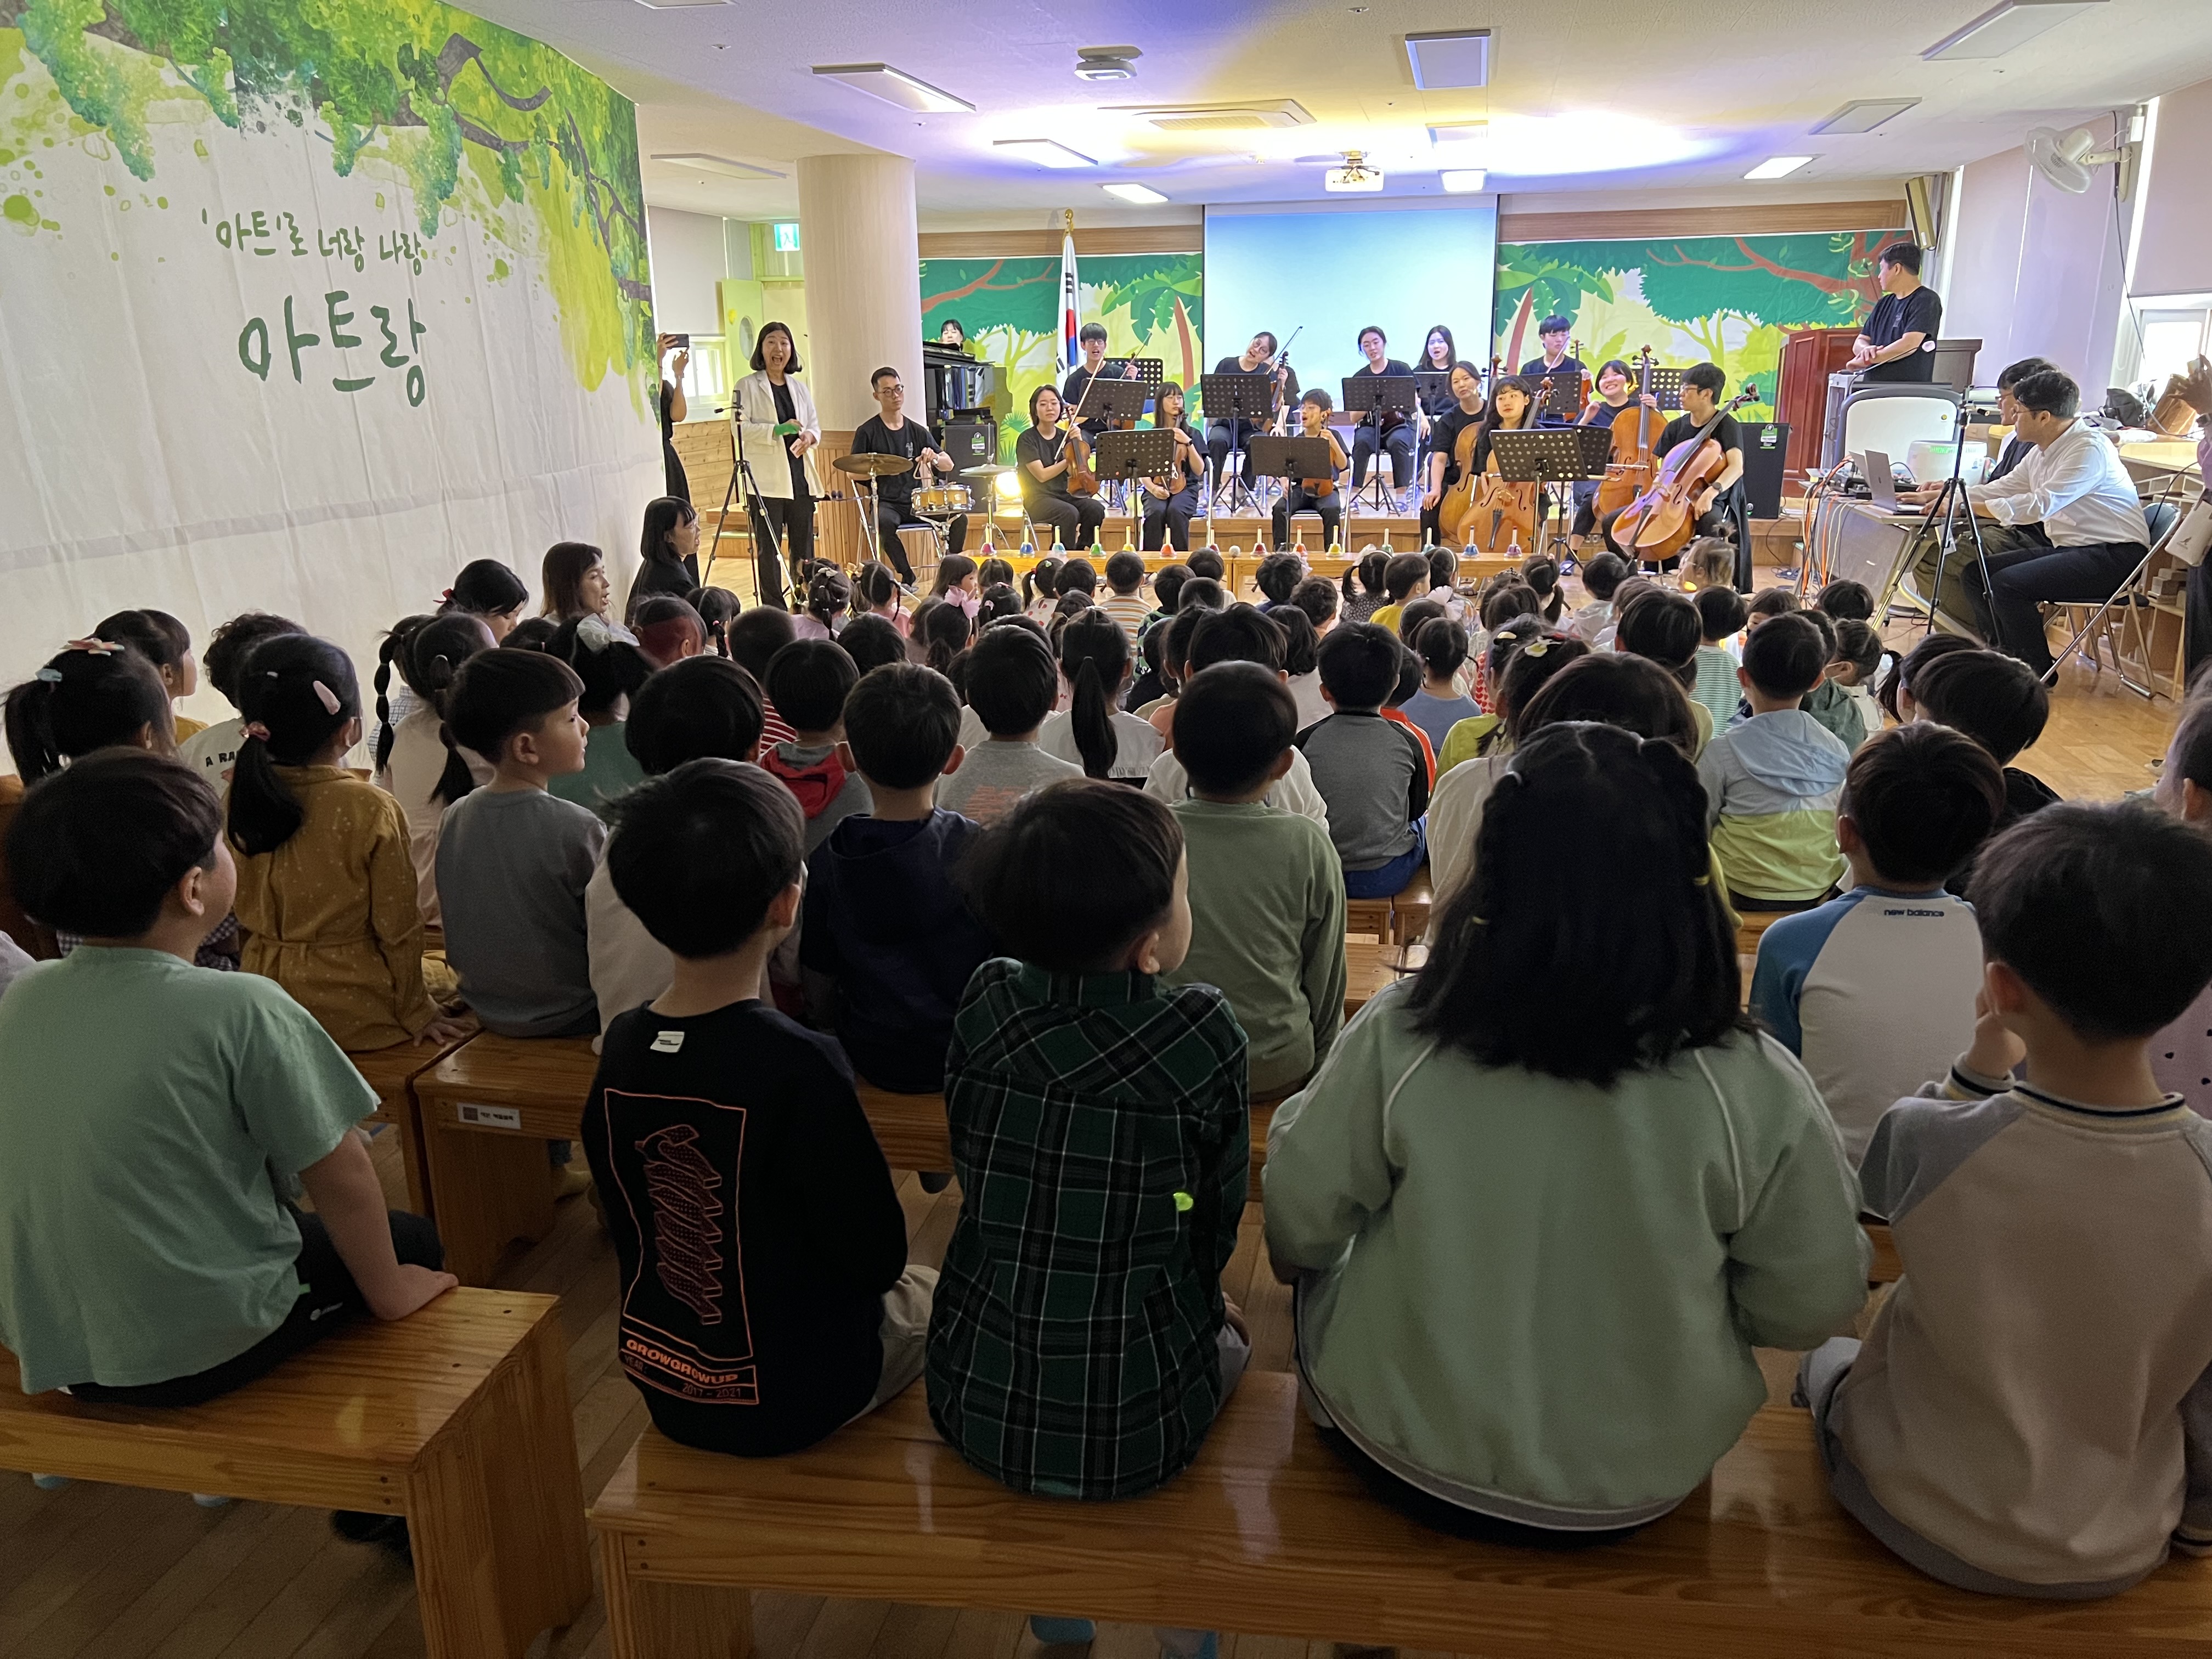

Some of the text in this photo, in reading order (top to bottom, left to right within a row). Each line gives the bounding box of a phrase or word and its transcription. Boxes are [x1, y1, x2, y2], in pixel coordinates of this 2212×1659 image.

[318, 225, 365, 273] 너랑
[379, 230, 422, 275] 나랑
[239, 290, 427, 407] 아트랑
[206, 751, 238, 767] A RA
[1907, 909, 1945, 917] balance
[682, 1383, 703, 1397] 2017
[716, 1387, 741, 1398] 2021
